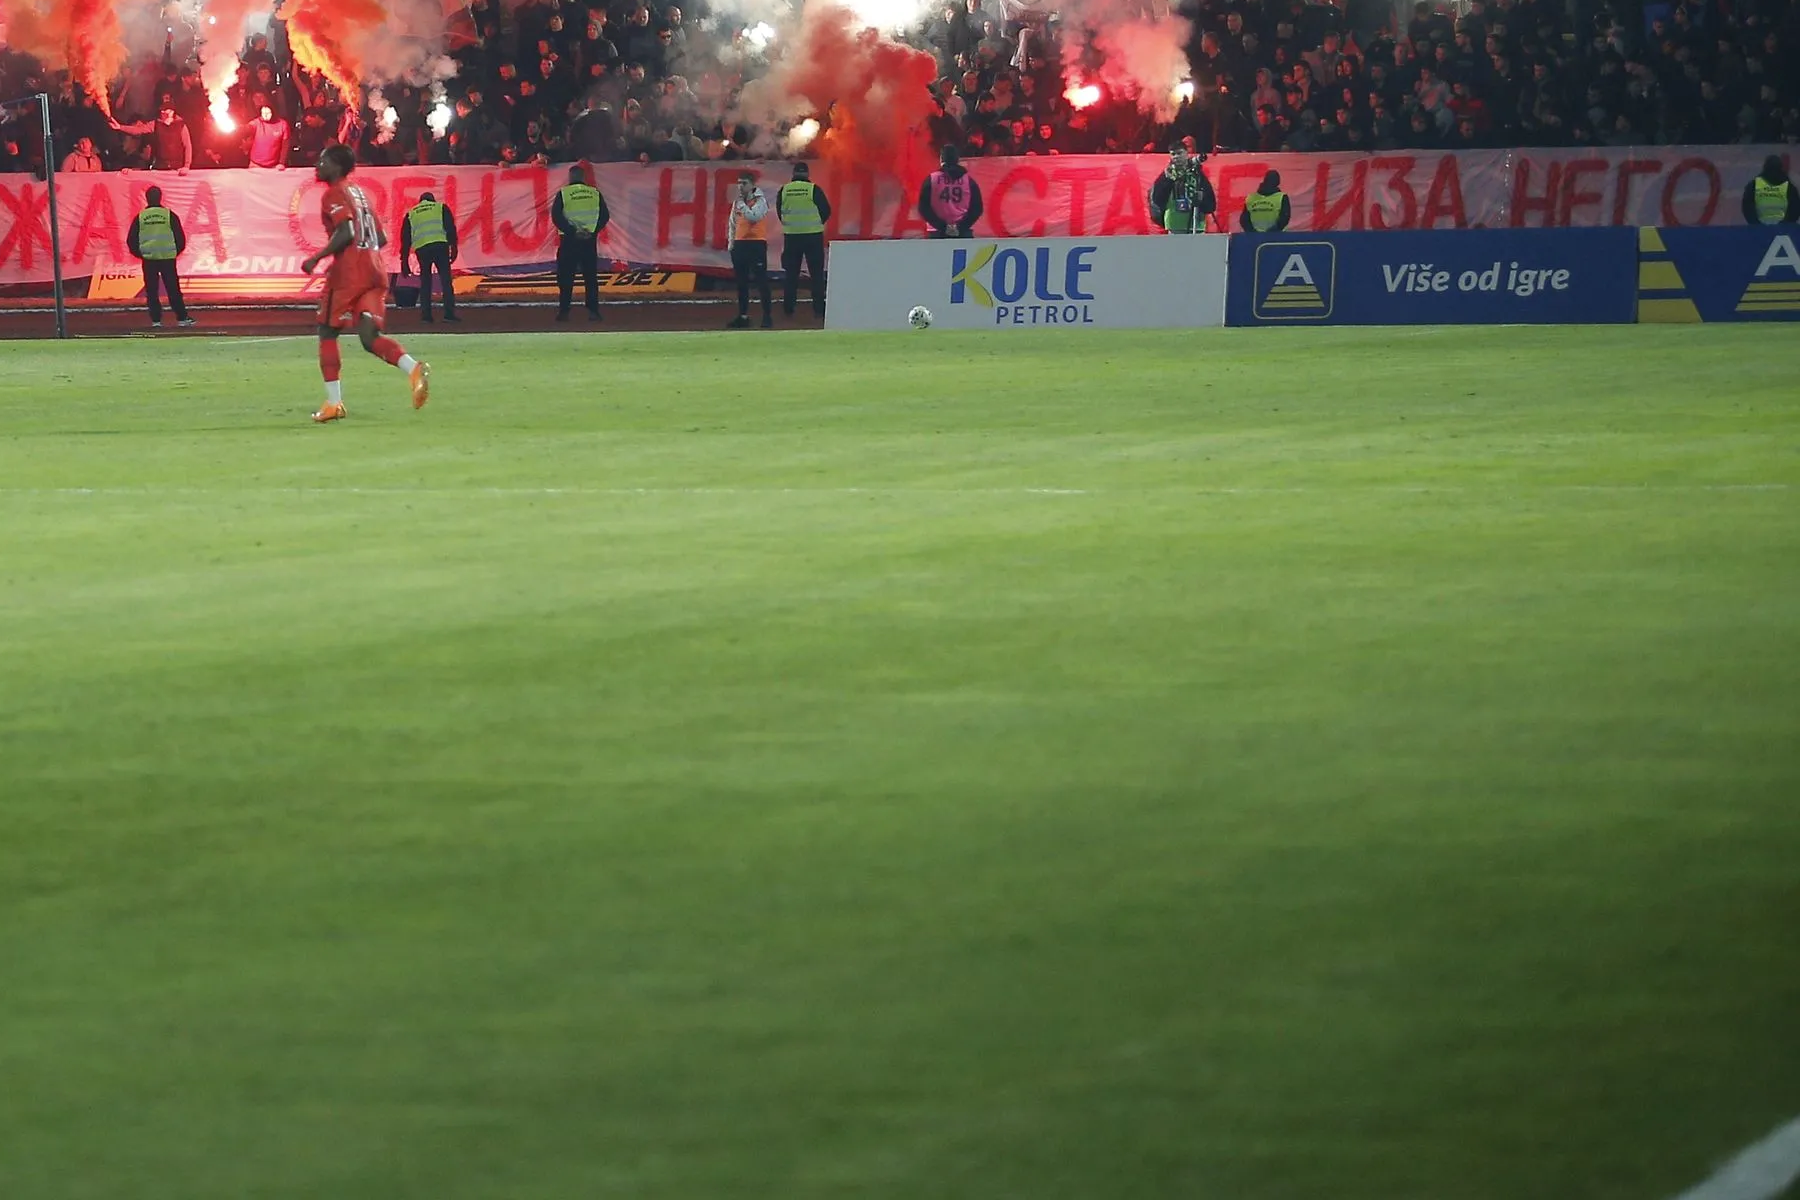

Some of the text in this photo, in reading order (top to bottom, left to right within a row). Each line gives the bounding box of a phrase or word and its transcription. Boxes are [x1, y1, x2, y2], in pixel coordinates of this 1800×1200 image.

[940, 186, 963, 203] 49
[988, 161, 1269, 237] СТАЕ
[950, 244, 1098, 309] KOLE
[1382, 261, 1570, 297] Više od igre
[996, 305, 1094, 324] PETROL
